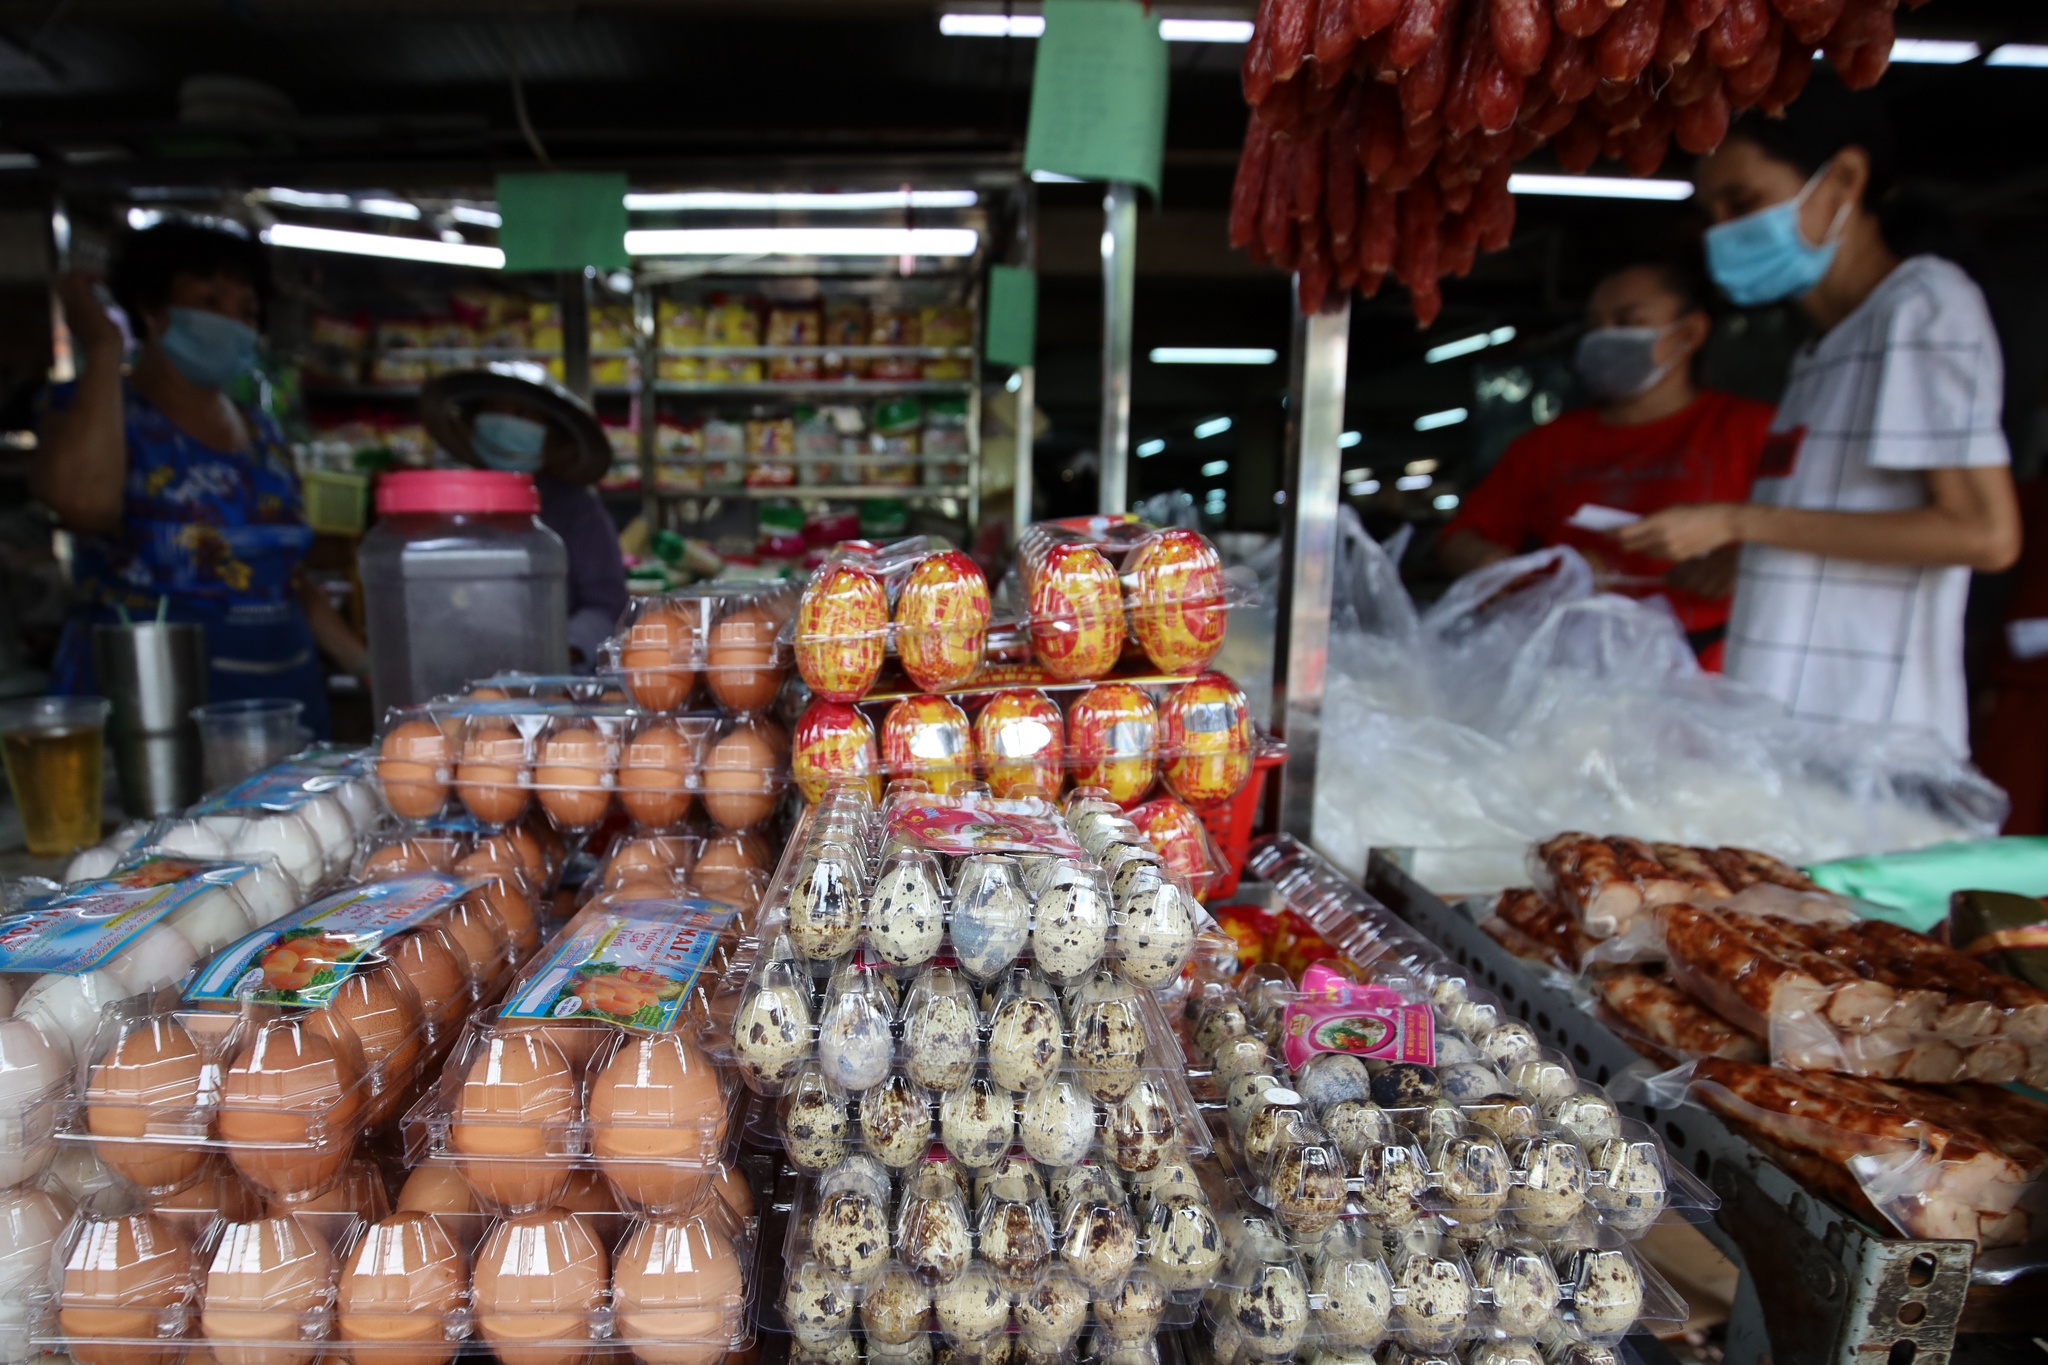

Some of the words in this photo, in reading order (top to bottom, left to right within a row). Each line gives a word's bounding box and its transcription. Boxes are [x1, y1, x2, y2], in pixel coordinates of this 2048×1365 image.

[610, 929, 633, 947] Tươi
[628, 932, 643, 944] Gà
[635, 927, 666, 952] Trứng
[671, 927, 700, 953] MAI
